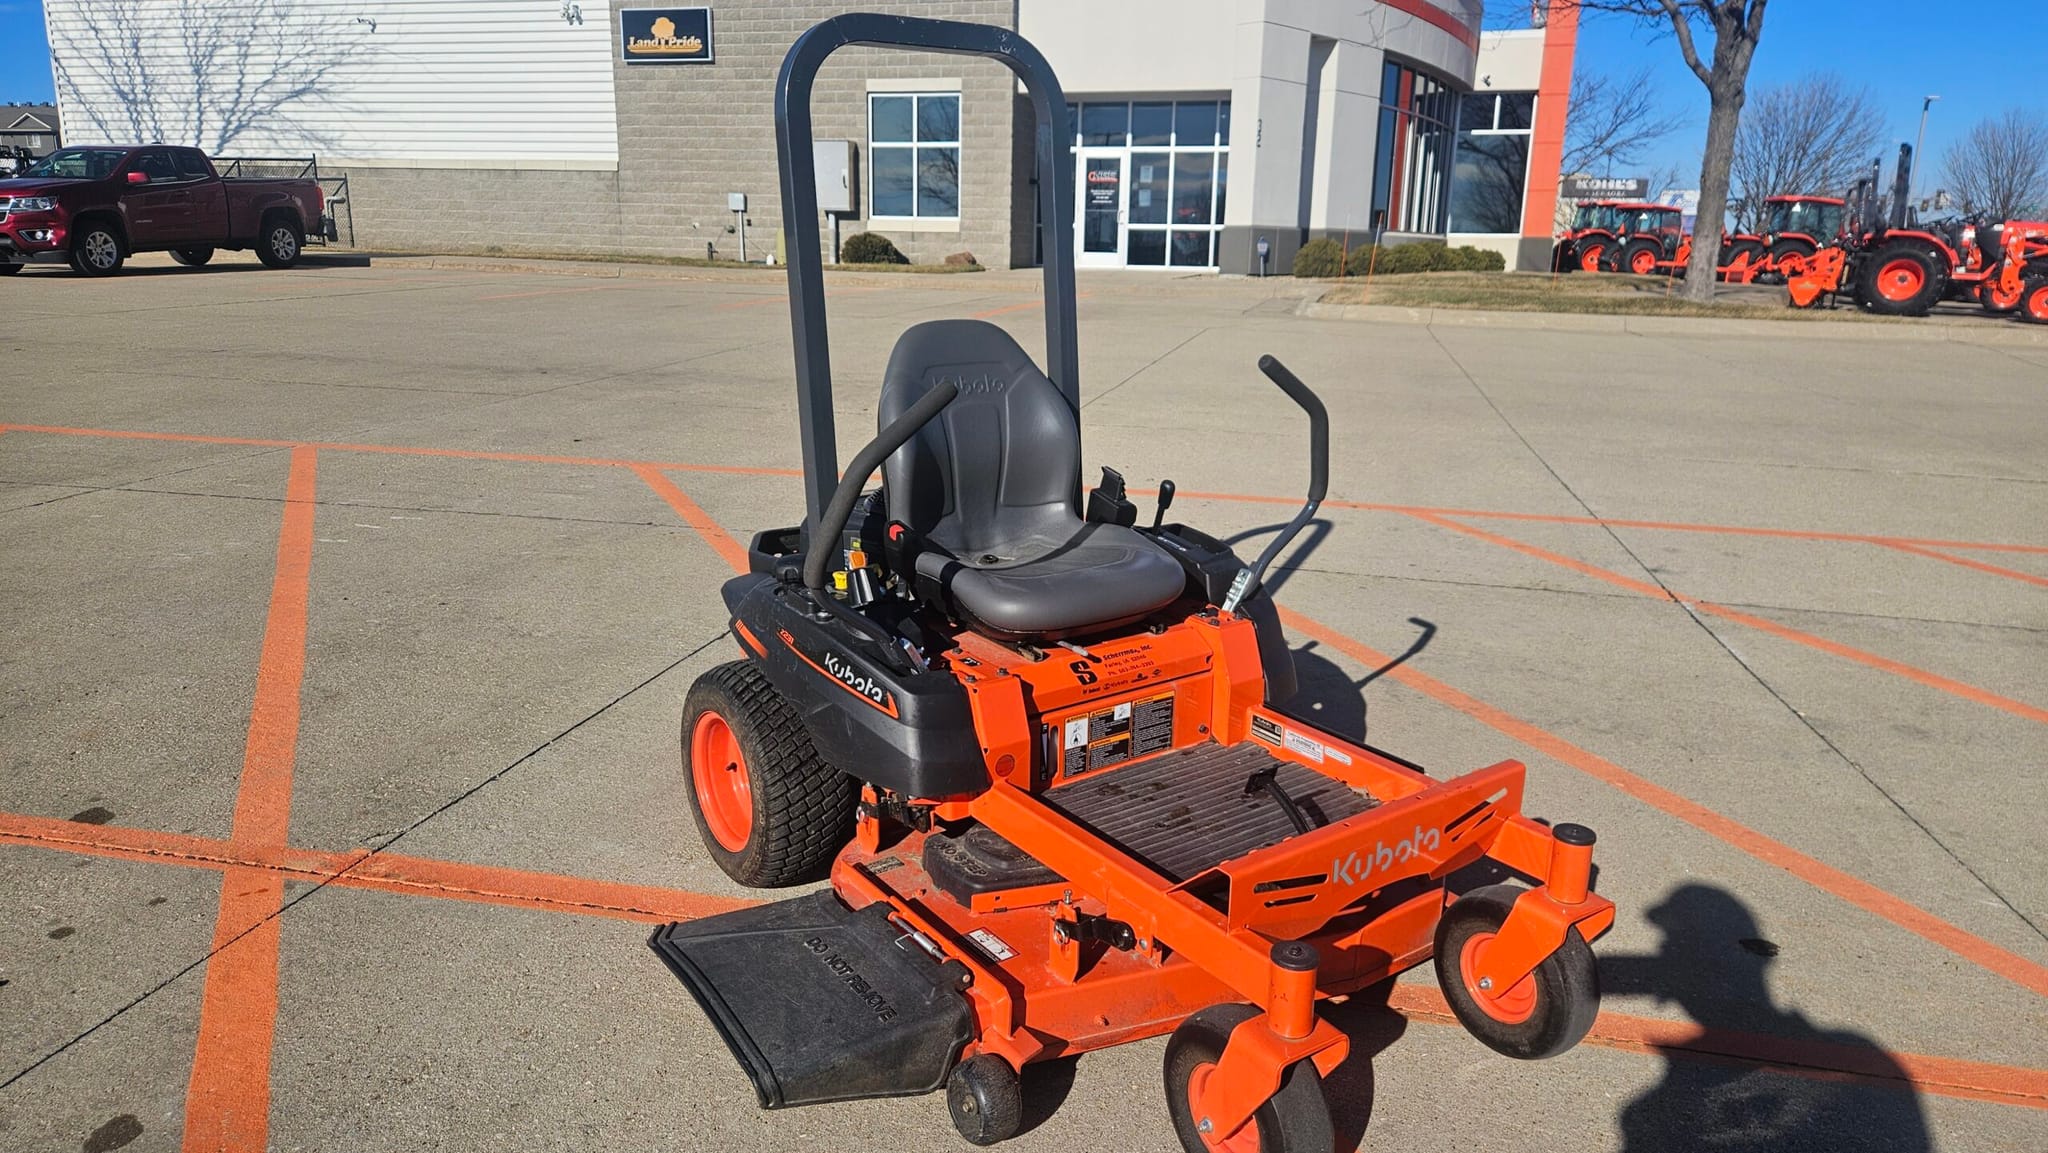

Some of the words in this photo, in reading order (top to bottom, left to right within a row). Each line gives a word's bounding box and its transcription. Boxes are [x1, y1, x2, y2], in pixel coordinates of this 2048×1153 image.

[629, 36, 659, 48] Land
[668, 35, 702, 48] Pride
[824, 652, 883, 703] Kubota
[953, 853, 988, 877] STEP
[1332, 825, 1440, 886] Kubota
[803, 936, 829, 955] DO
[823, 953, 854, 978] NOT
[845, 973, 898, 1024] REMOVE
